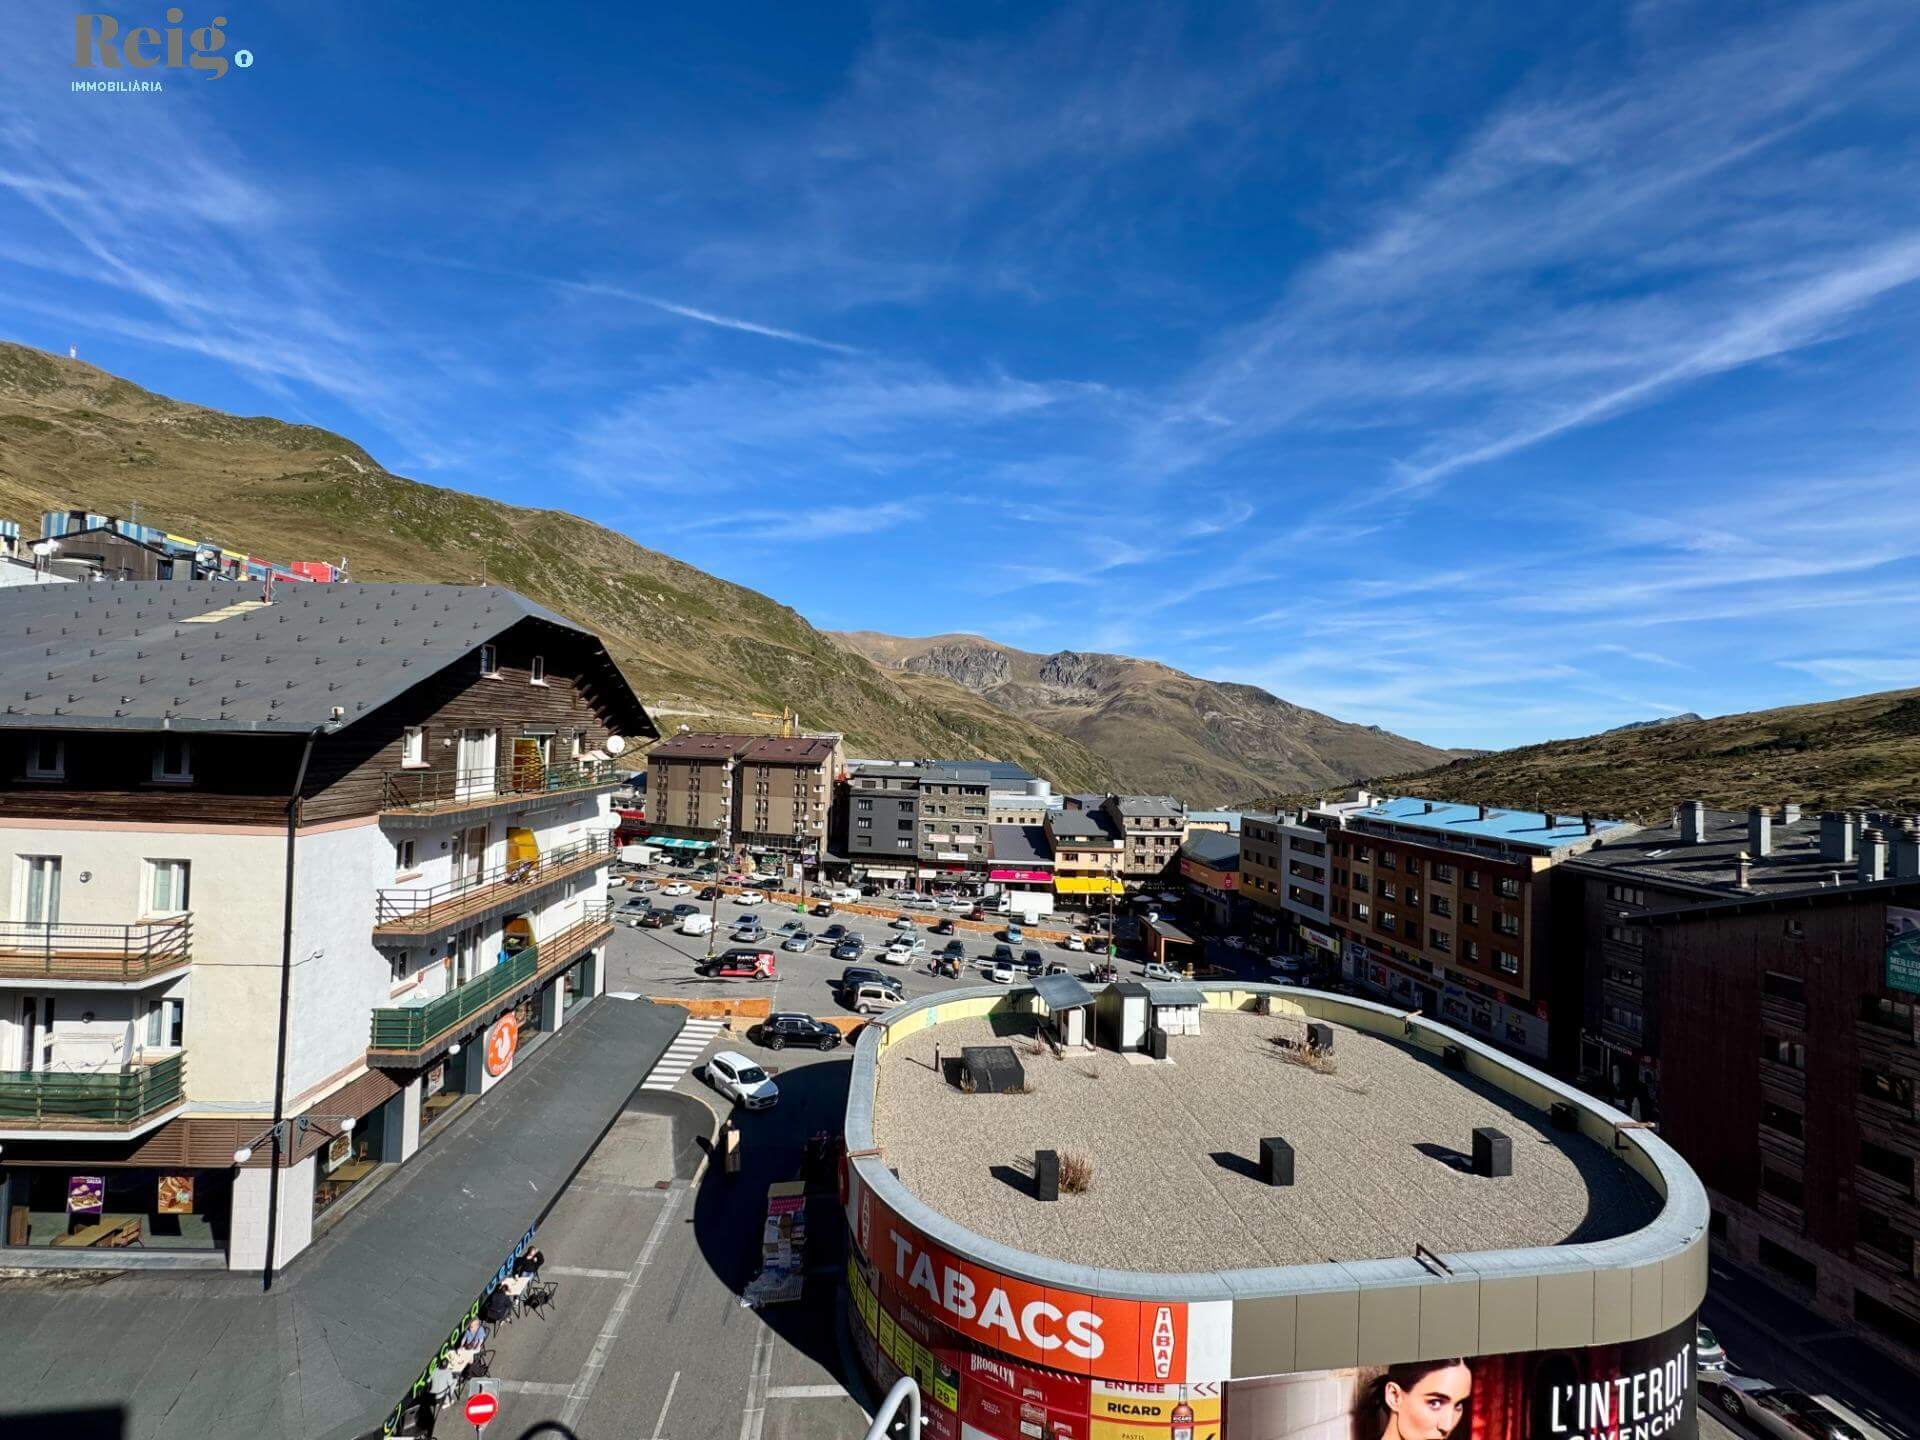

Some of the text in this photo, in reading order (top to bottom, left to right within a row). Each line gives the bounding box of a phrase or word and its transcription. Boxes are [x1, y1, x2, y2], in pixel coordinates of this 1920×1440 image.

[889, 1230, 1104, 1359] TABACS
[1156, 1311, 1170, 1374] TABAC
[971, 1353, 1015, 1389] BROOKLYN
[1552, 1343, 1690, 1432] L'INTERDIT
[937, 1388, 950, 1404] 29
[1107, 1402, 1162, 1416] RICARD
